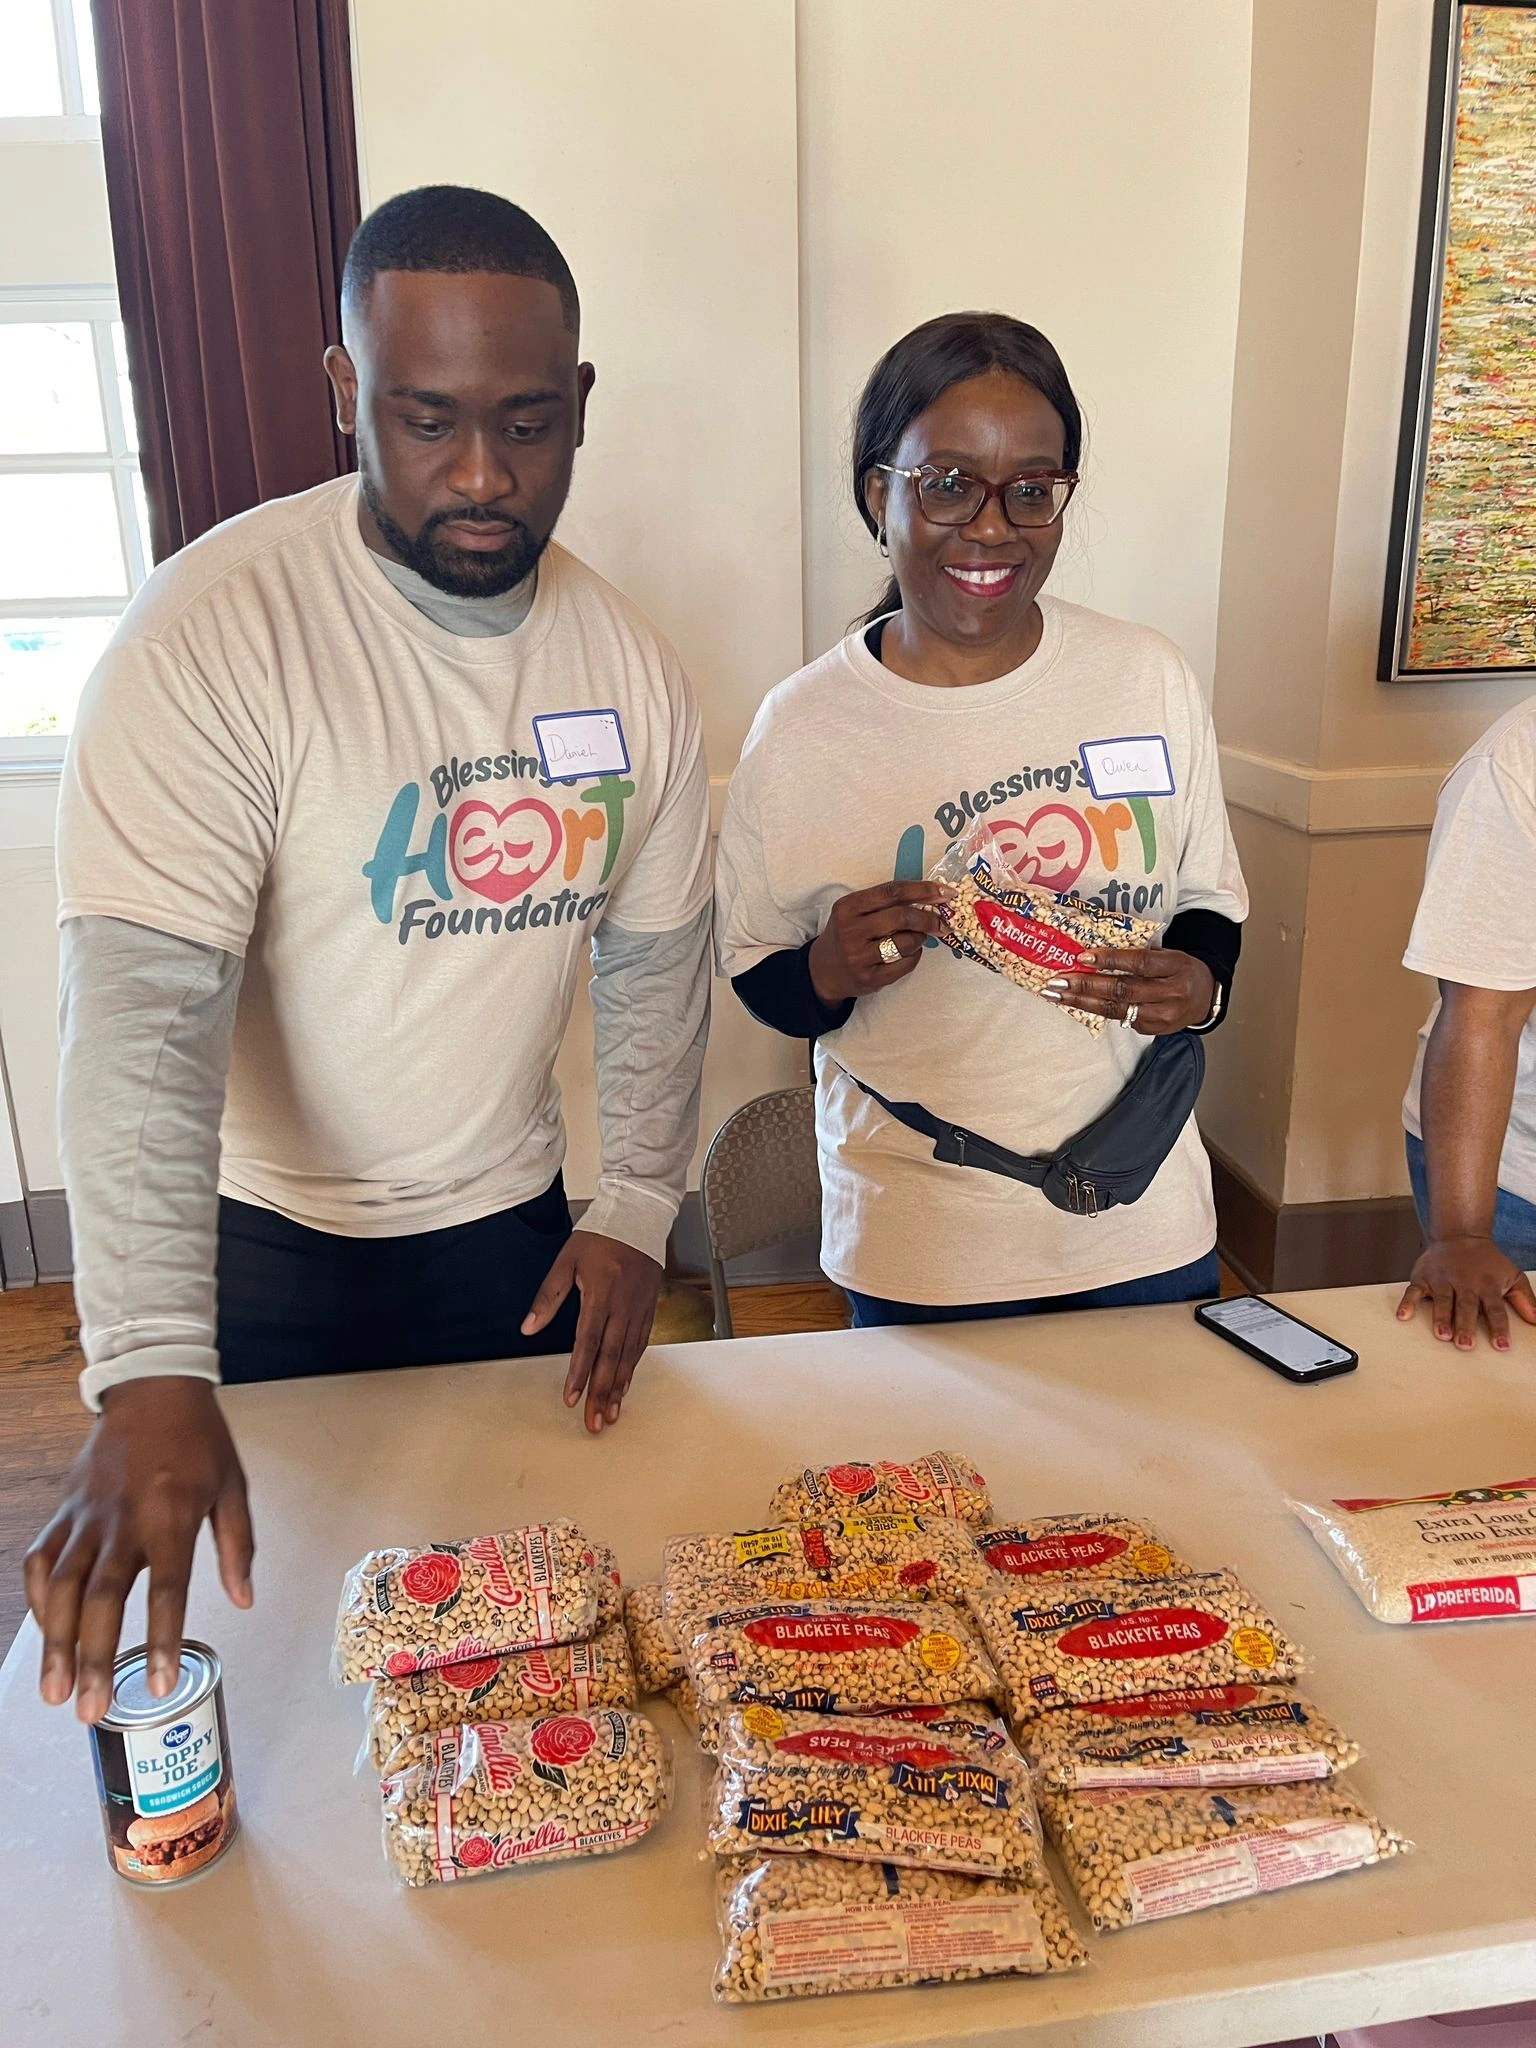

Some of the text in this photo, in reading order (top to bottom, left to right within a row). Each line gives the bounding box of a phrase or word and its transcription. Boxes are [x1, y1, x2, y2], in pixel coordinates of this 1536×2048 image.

[430, 750, 577, 808] Blessin
[934, 759, 1090, 838] Blessing's
[1003, 892, 1029, 909] LILY
[990, 915, 1076, 968] BLACKEYE PEAS
[1024, 922, 1055, 941] U.S. No. 1
[866, 1524, 898, 1532] DRIED
[1414, 1513, 1529, 1531] Extra Long
[993, 1532, 1017, 1541] LILY
[1421, 1531, 1486, 1544] Grano
[529, 1536, 548, 1582] BLACKEYES
[1004, 1542, 1105, 1566] BLACKEYE PEAS
[1453, 1558, 1468, 1566] NET
[469, 1535, 523, 1606] Camellia
[829, 1565, 893, 1595] CHINA
[377, 1586, 389, 1610] SINCE
[765, 1580, 826, 1600] DOLL
[1416, 1586, 1517, 1614] LA PREFERIDA
[1027, 1602, 1103, 1629] DIXIE LILY
[1120, 1617, 1137, 1626] U.S.
[1153, 1615, 1159, 1623] 1
[776, 1623, 891, 1639] BLACKEYE PEAS
[1088, 1622, 1202, 1650] BLACKEYE PEAS
[419, 1637, 534, 1669] Camellia BLACKEYES
[573, 1644, 588, 1672] BLACK
[714, 1658, 735, 1667] USA
[1033, 1680, 1054, 1691] USA
[166, 1728, 190, 1744] Kroger
[809, 1736, 937, 1754] BLACKEYE PEAS
[1211, 1734, 1268, 1749] BLACKEYE
[137, 1728, 213, 1774] SLOPPY
[469, 1722, 522, 1792] Camellia
[163, 1758, 198, 1785] JOE
[902, 1771, 994, 1794] DIXIE LILY
[751, 1806, 845, 1832] DIXIE LILY
[493, 1820, 622, 1866] Camellia BLACKEYES
[886, 1827, 982, 1850] BLACKEYE PEAS
[1195, 1843, 1211, 1852] HOW
[1211, 1841, 1220, 1849] TO
[1221, 1836, 1239, 1847] COOK
